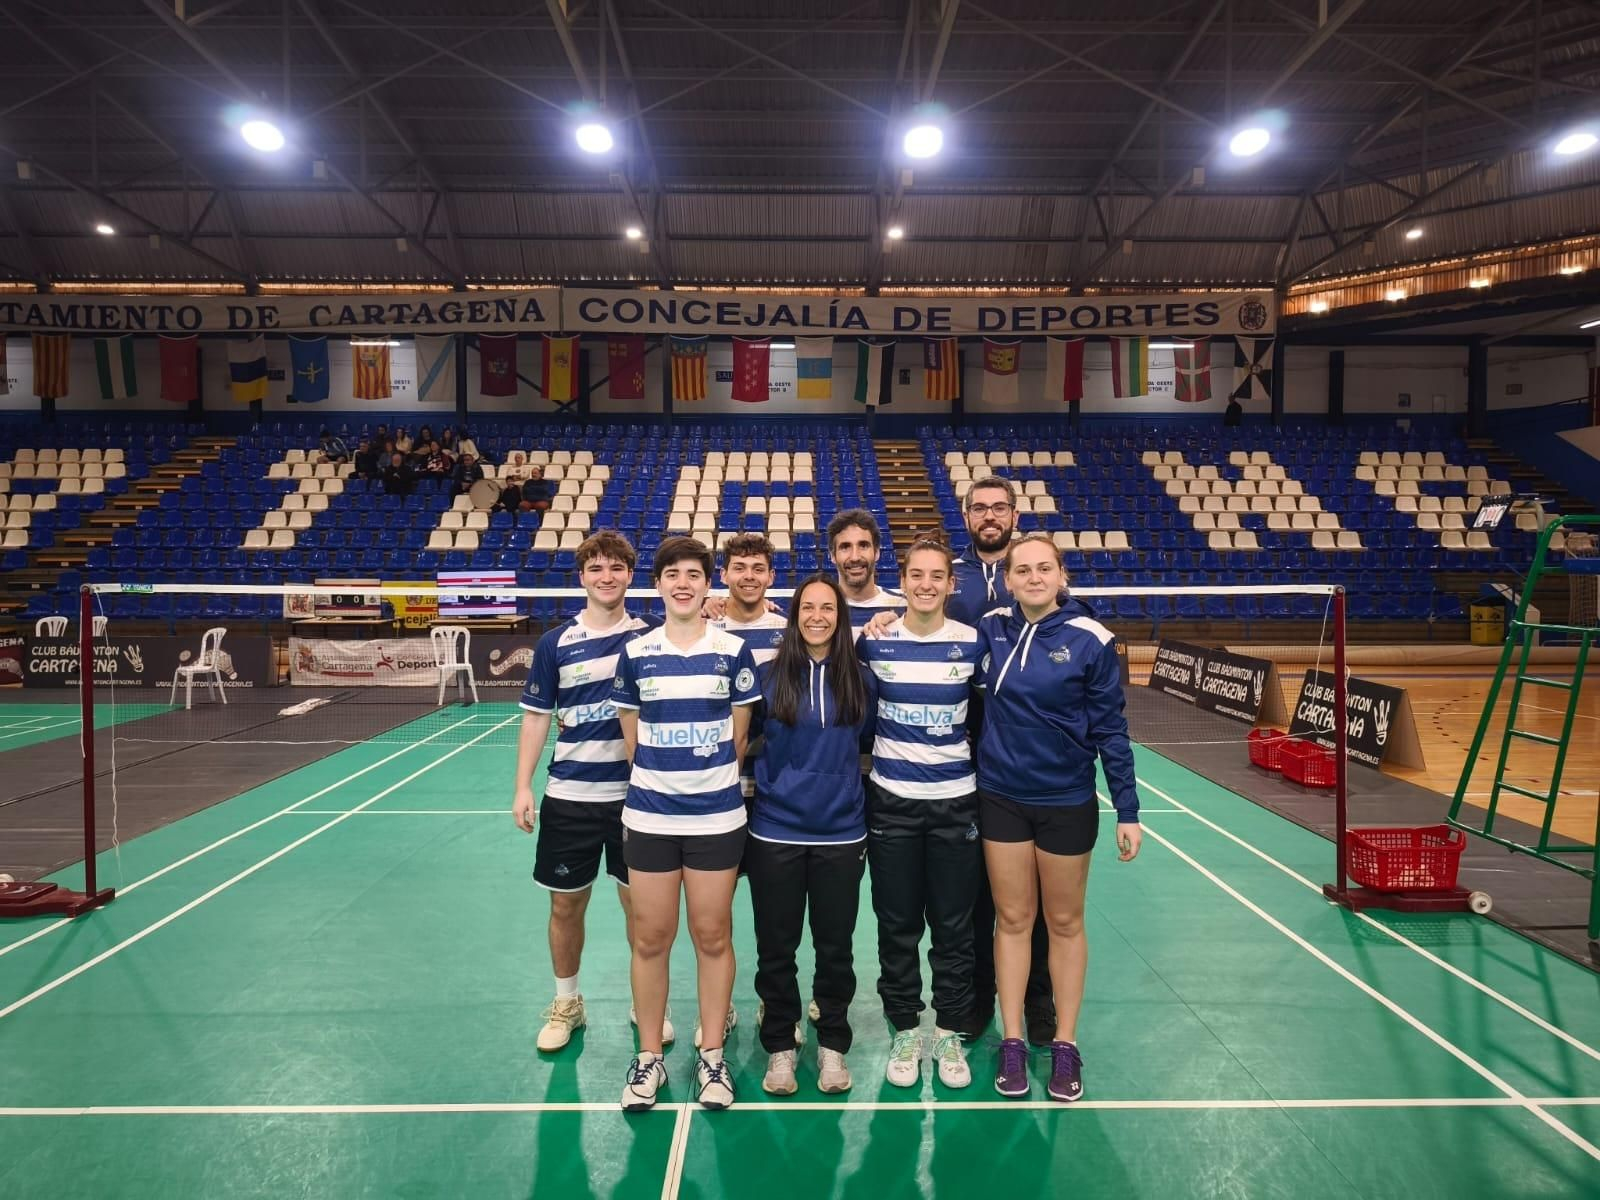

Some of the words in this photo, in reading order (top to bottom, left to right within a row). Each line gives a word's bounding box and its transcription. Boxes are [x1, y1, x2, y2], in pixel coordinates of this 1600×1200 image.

[0, 302, 203, 330] TAMIENTO
[226, 306, 281, 330] DE
[309, 298, 546, 327] CARTAGENA
[579, 297, 869, 330] CONCEJALÍA
[893, 306, 951, 331] DE
[978, 301, 1220, 331] DEPORTES
[31, 646, 58, 656] CLUB
[321, 662, 373, 672] Cartagena
[1153, 661, 1191, 685] CARTAGENA
[1207, 661, 1221, 674] CLUB
[1202, 676, 1248, 703] CARTAGENA
[1304, 683, 1324, 699] CLUB
[649, 723, 721, 746] Huelva
